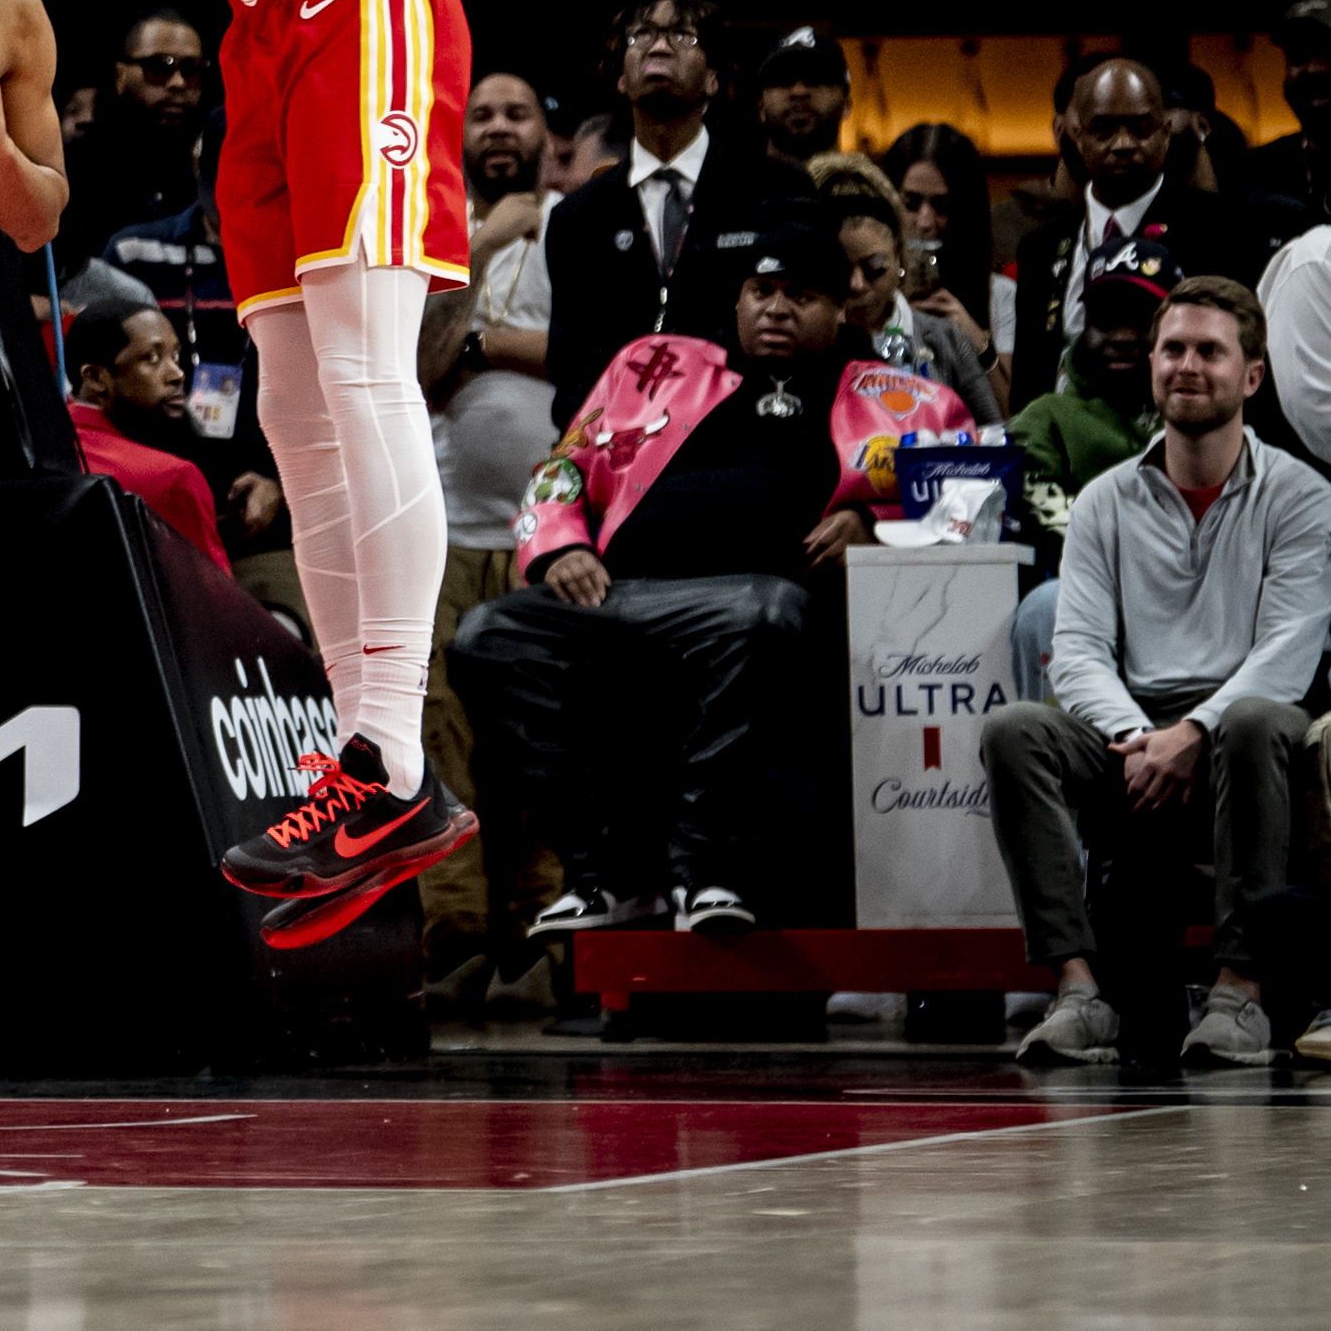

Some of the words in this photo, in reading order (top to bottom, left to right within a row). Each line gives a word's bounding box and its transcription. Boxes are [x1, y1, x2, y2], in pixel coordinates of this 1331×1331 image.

[878, 653, 982, 680] Michelob
[857, 681, 1008, 717] ULTRA
[871, 777, 989, 815] Courtsid
